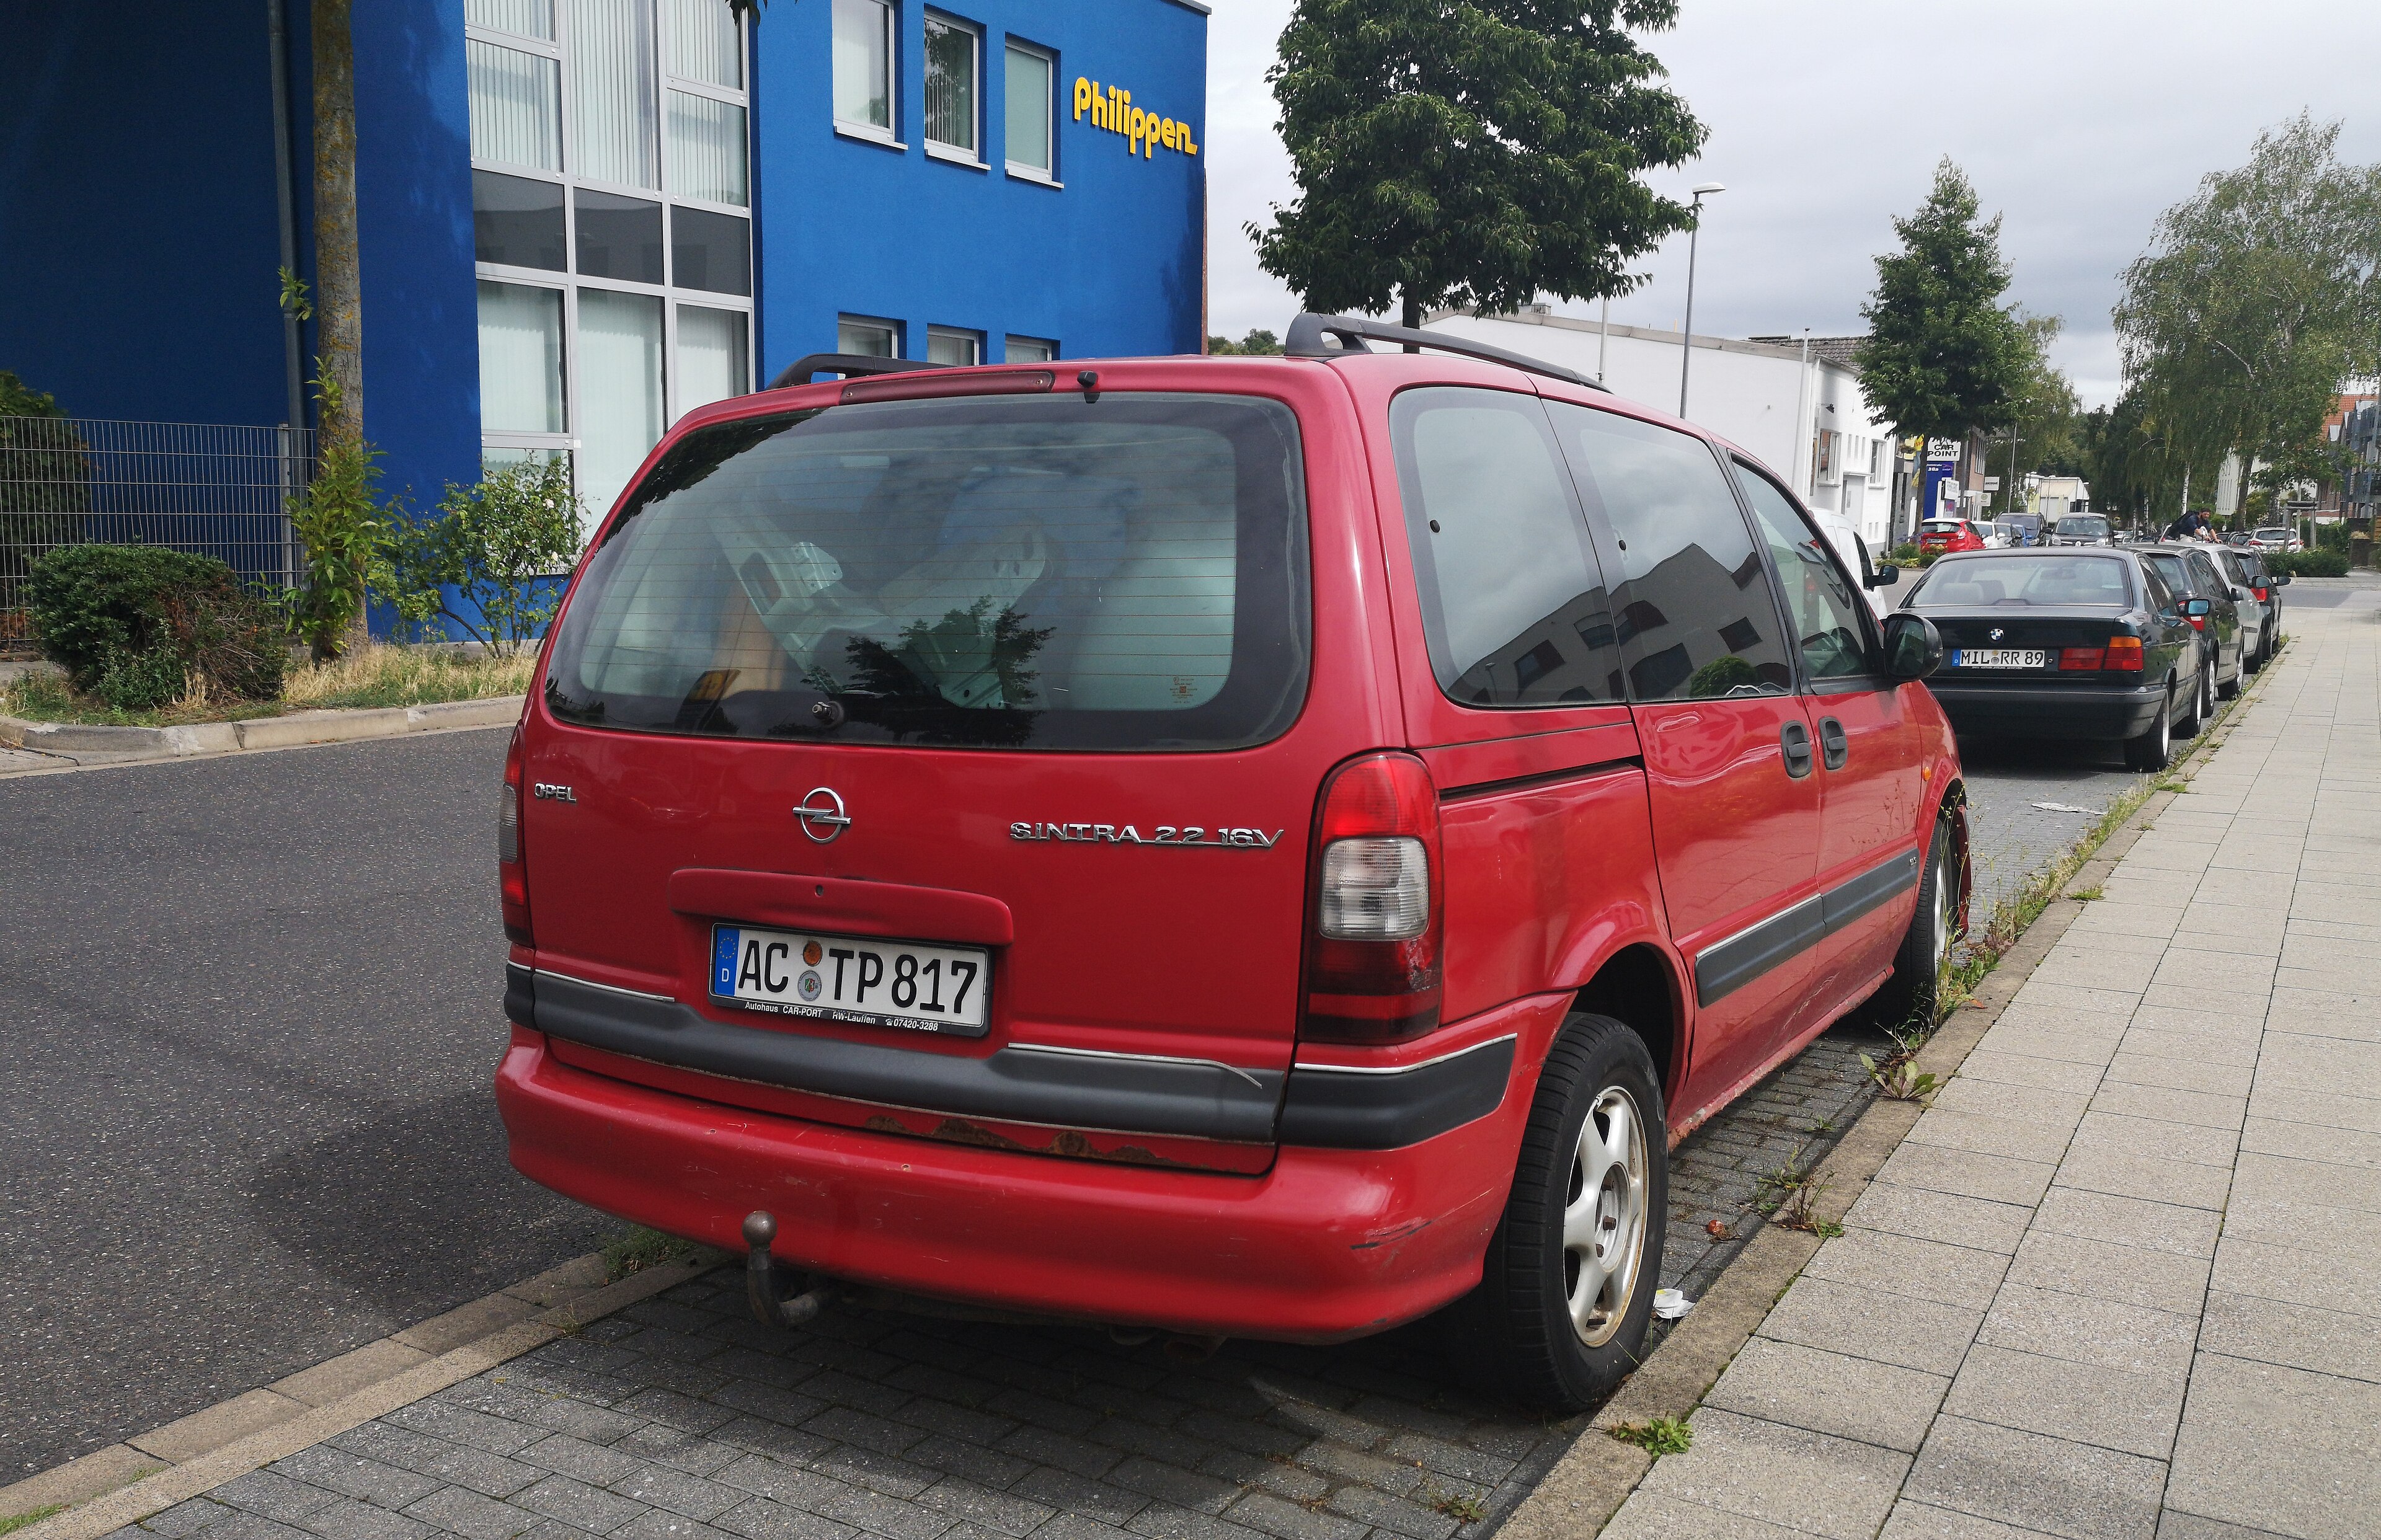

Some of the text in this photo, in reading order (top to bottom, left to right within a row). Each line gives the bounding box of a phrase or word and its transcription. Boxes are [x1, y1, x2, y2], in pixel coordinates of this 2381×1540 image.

[1074, 77, 1198, 159] Philippen
[1961, 651, 2044, 665] MIL RR 89
[534, 783, 577, 802] OPEL
[1010, 822, 1142, 844] SINTRA
[1218, 828, 1284, 847] 16V
[721, 967, 730, 983] D
[738, 939, 789, 993] AC
[745, 1001, 779, 1012] Autohaus
[783, 1006, 823, 1018] CAR-PORT
